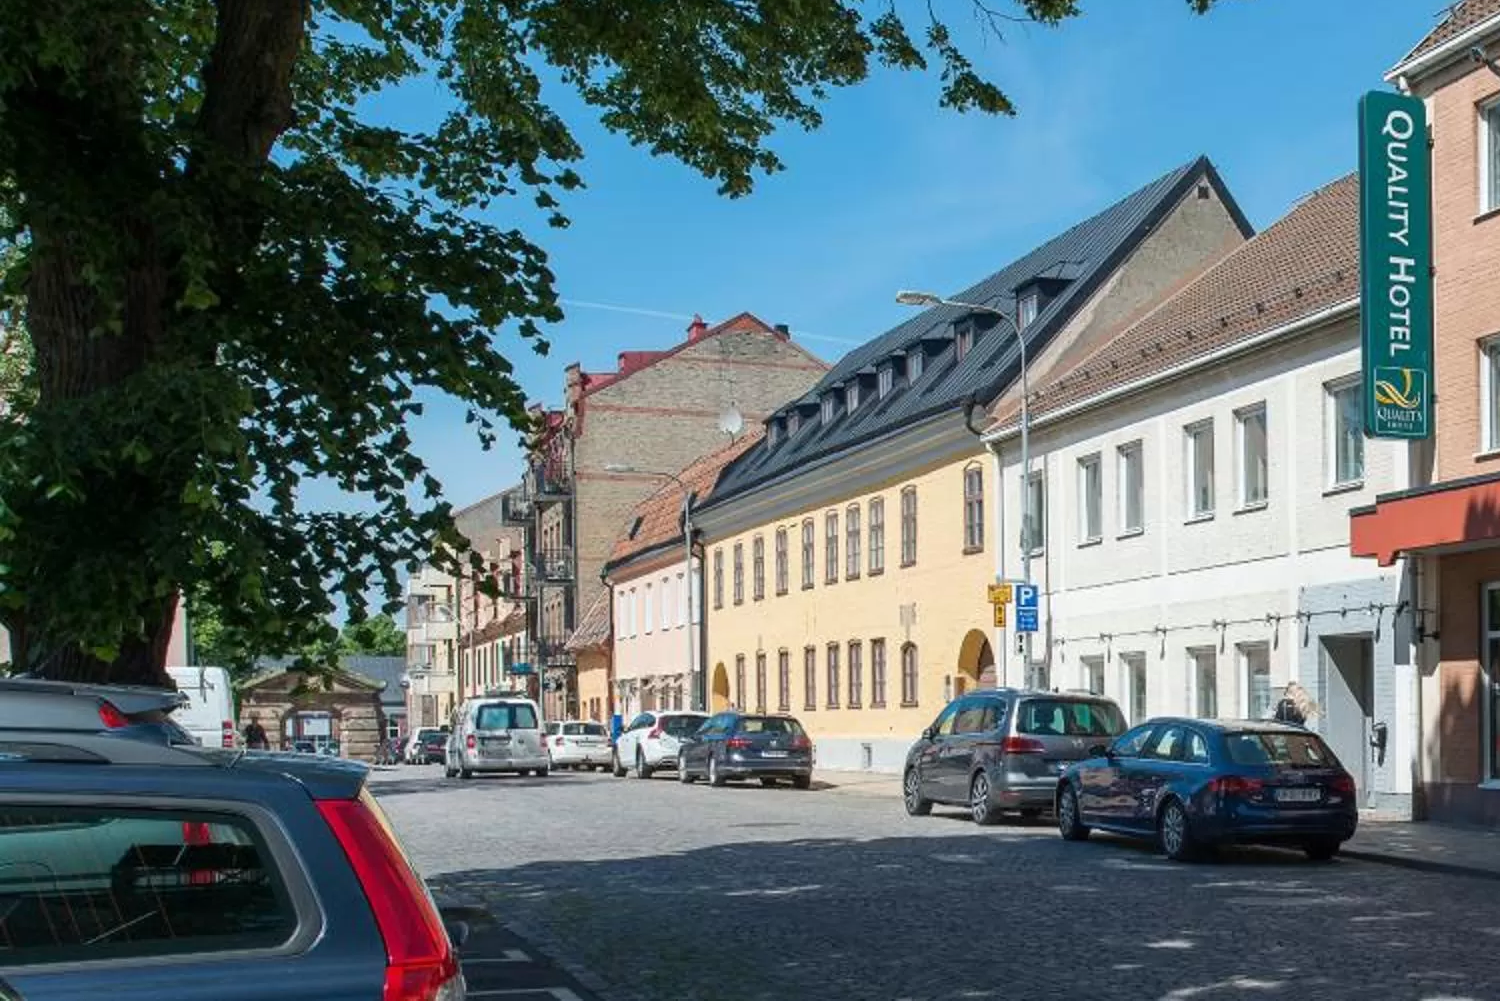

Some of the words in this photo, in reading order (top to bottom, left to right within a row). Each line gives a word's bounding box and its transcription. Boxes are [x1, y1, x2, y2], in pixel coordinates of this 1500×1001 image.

[1381, 110, 1414, 247] QUALITY
[1389, 256, 1415, 358] HOTEL
[1021, 587, 1033, 605] P
